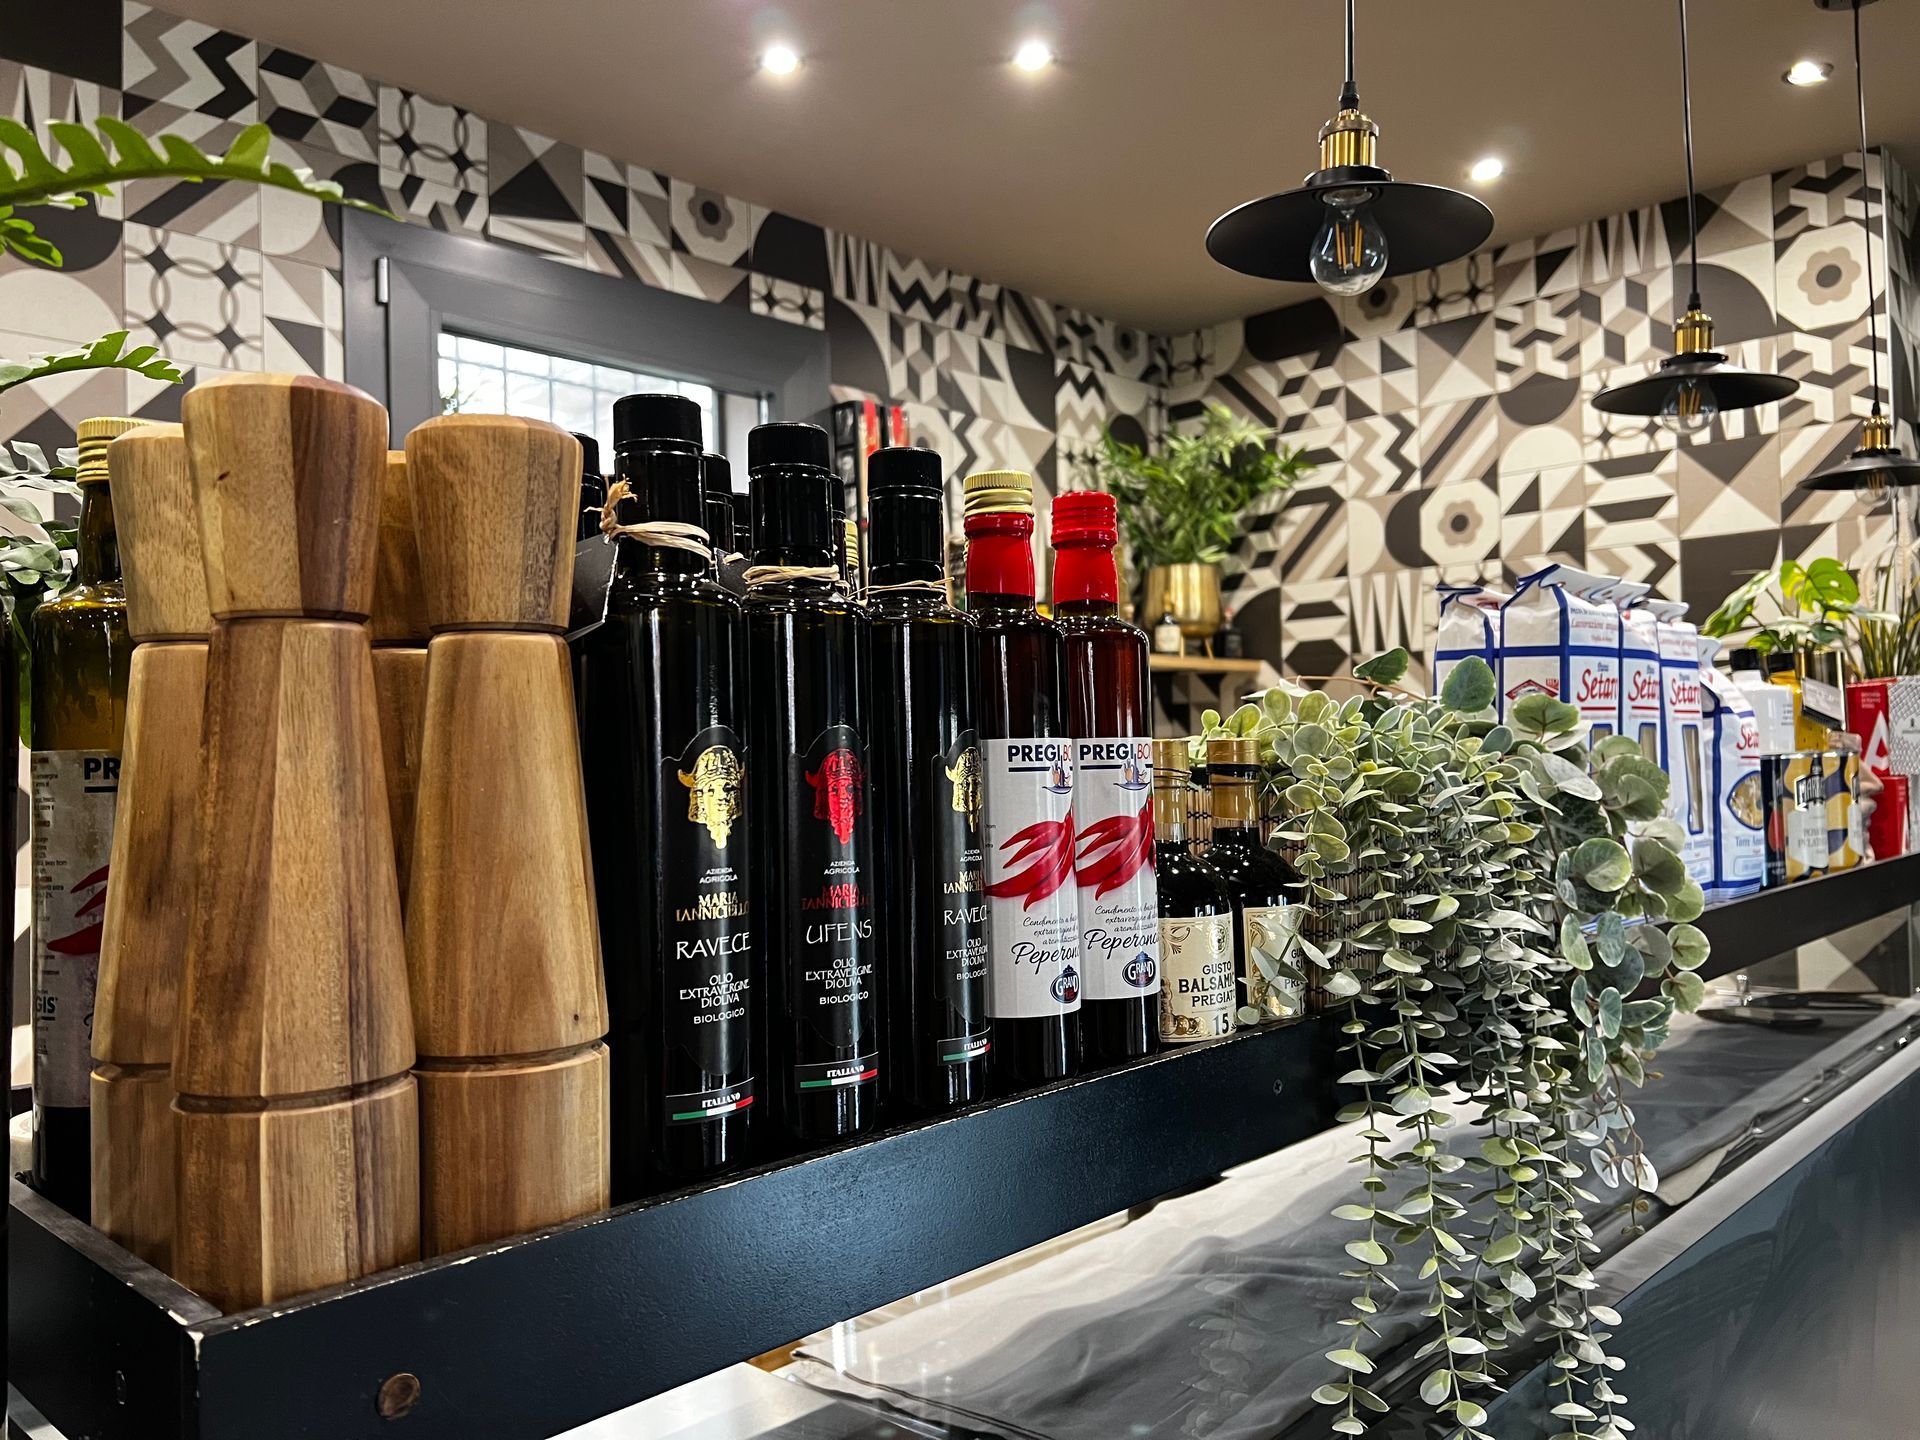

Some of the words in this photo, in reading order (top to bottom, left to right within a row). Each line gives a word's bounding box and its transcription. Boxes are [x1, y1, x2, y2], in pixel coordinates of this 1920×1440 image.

[706, 867, 733, 875] AZIENDA
[824, 867, 860, 875] AGRICOLA
[699, 874, 738, 884] AGRICOLA
[698, 891, 738, 907] MARIA
[806, 919, 872, 944] UFENS
[676, 932, 751, 960] RAVECE
[966, 938, 981, 948] OLIO
[833, 957, 855, 969] OLIO
[1127, 961, 1154, 980] GRAND
[1202, 961, 1232, 976] GUSTO
[709, 972, 733, 986] OLIO
[805, 964, 872, 981] EXTRAVERGINE
[679, 978, 750, 1000] EXTRAVERGINE
[825, 980, 836, 990] DI
[836, 977, 862, 988] OLIVA
[701, 998, 713, 1008] DI
[713, 993, 740, 1008] OLIVA
[819, 991, 869, 1005] BIOLOGICO
[693, 1007, 745, 1024] BIOLOGICO
[1212, 1013, 1230, 1035] 15
[827, 1065, 865, 1078] ITALIANO
[702, 1092, 741, 1108] ITALIANO
